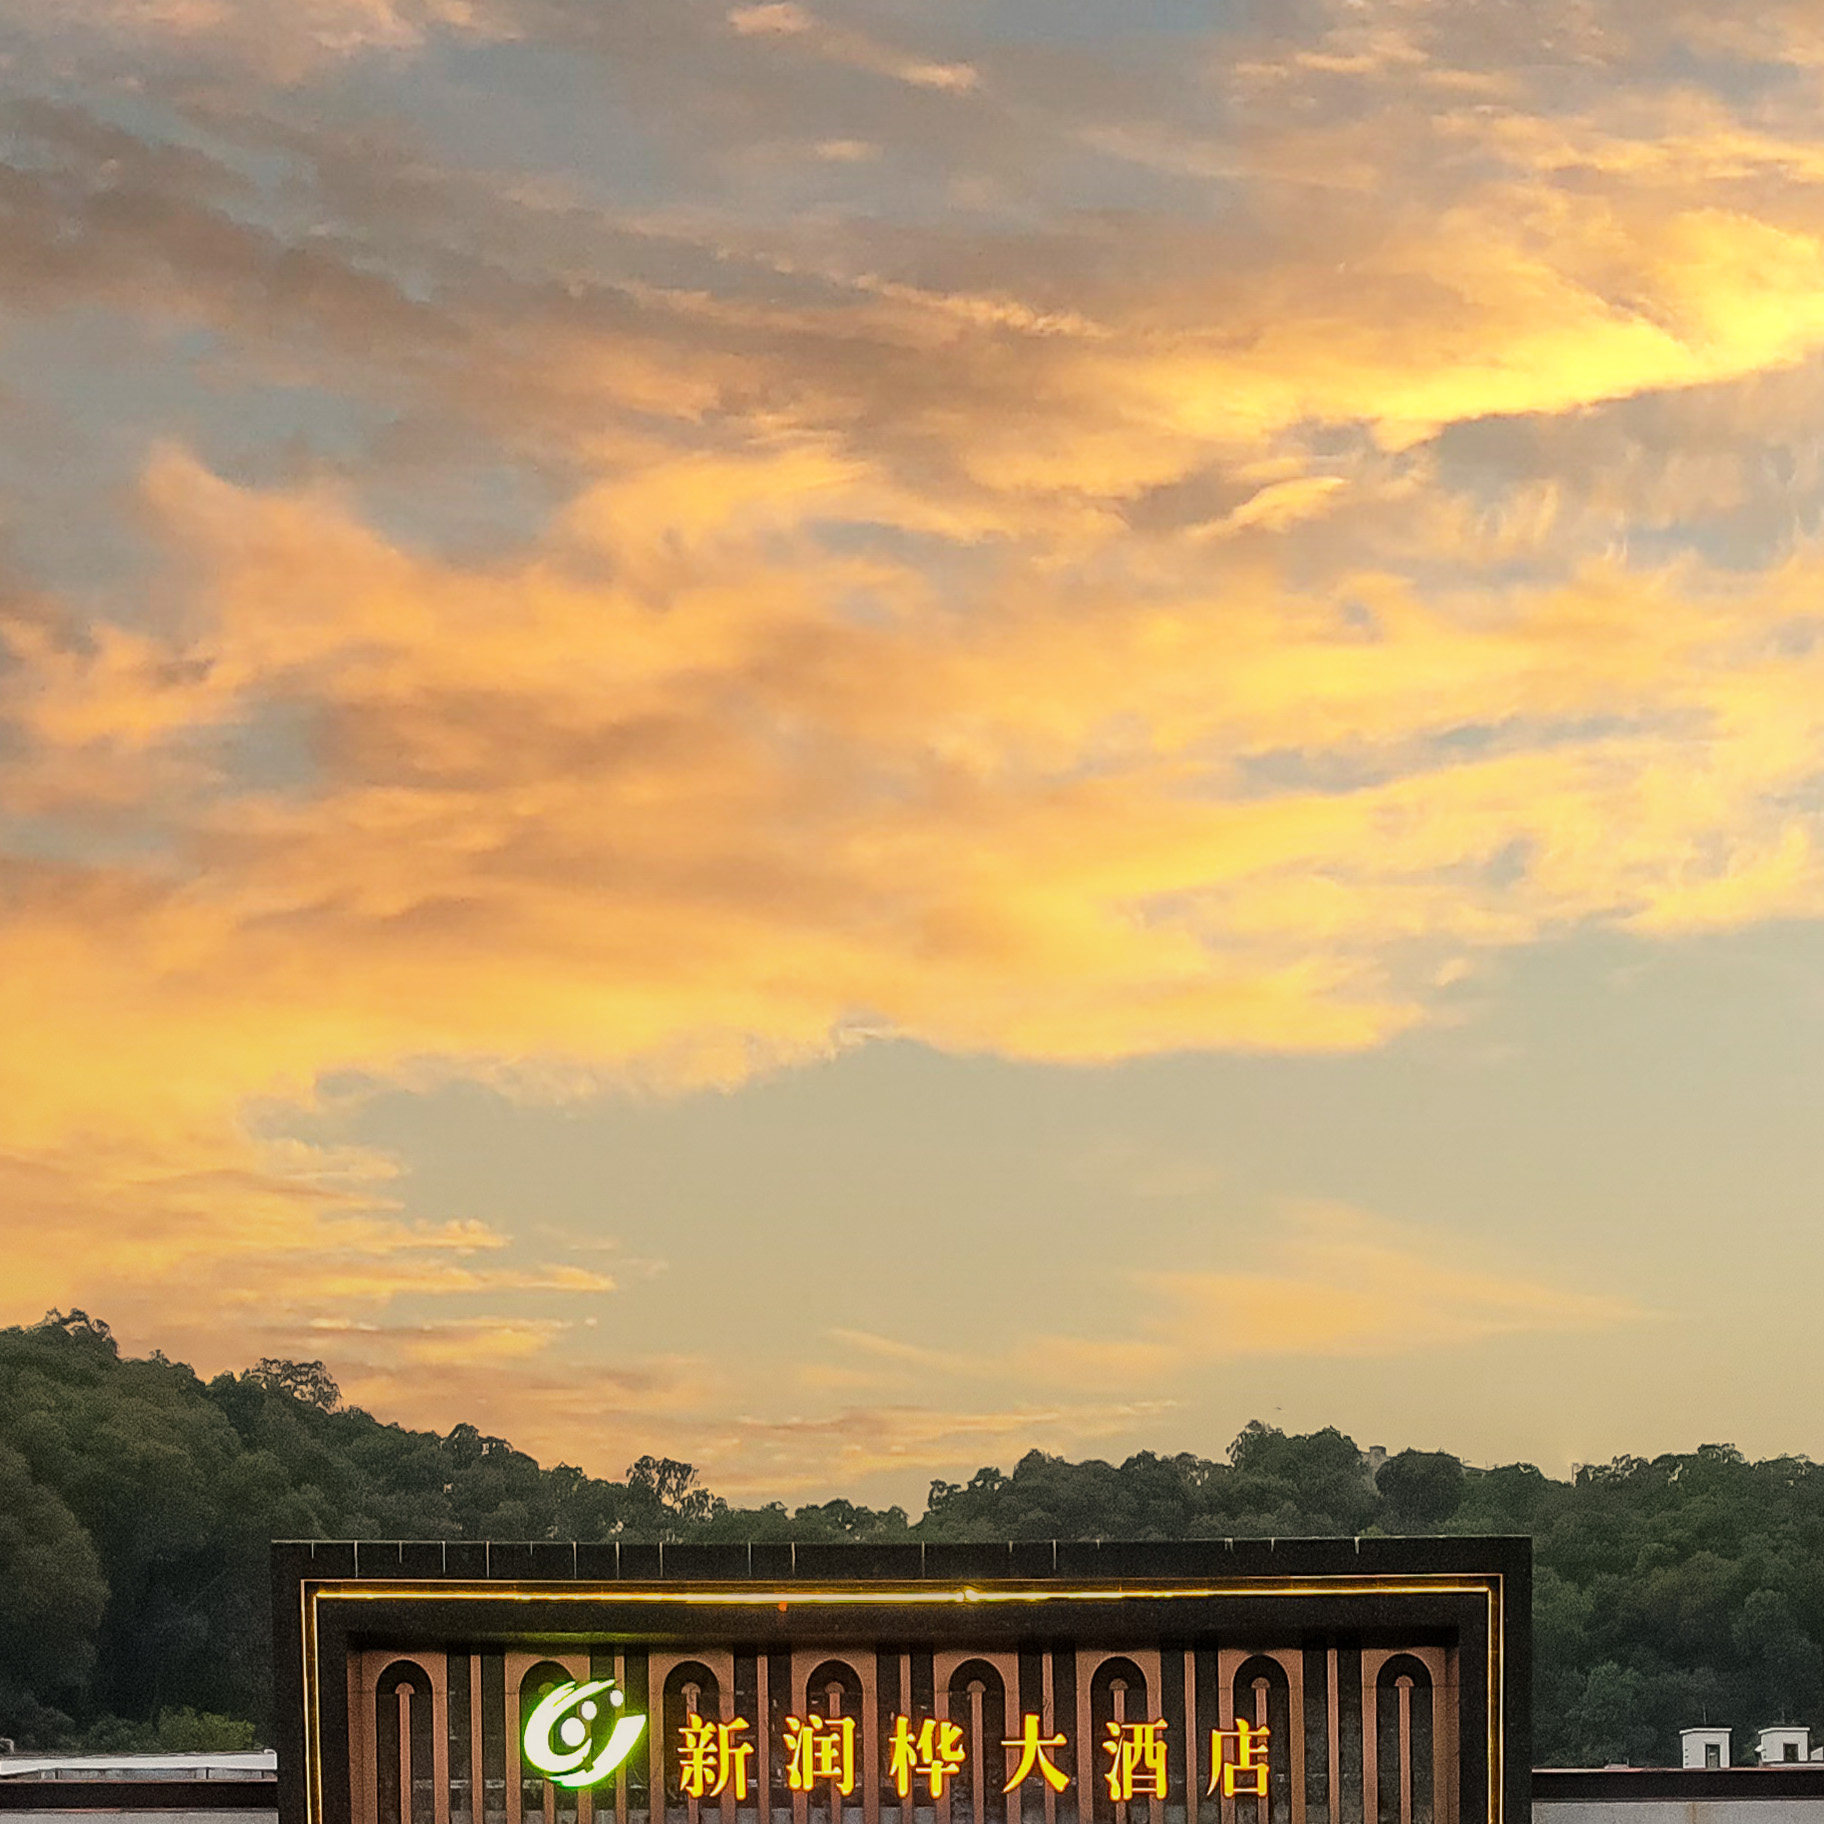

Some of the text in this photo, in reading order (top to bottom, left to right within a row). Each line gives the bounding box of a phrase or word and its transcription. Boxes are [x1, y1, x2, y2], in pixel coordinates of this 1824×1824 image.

[676, 1712, 1271, 1801] 新润桦大酒店
